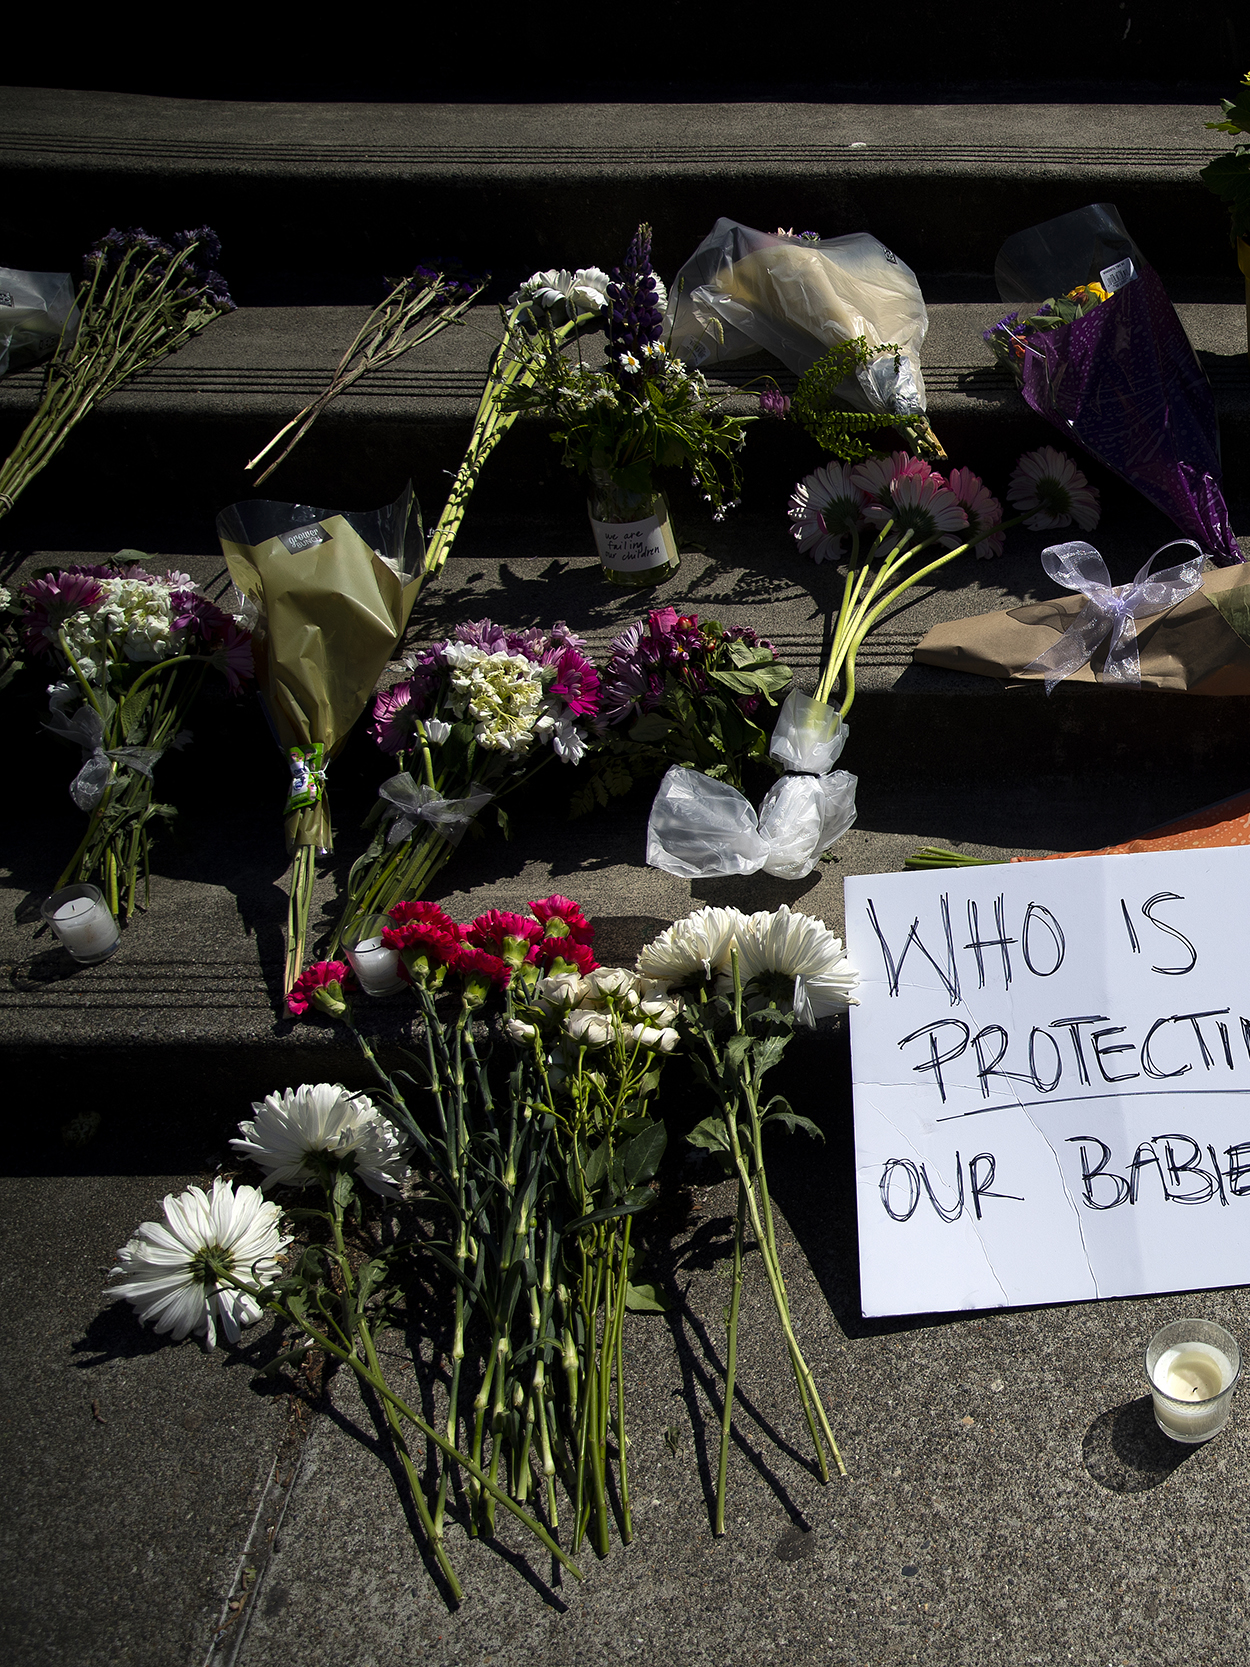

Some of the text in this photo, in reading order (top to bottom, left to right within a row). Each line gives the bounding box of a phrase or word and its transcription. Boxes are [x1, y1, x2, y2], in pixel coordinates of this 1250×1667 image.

[288, 528, 319, 548] grower
[296, 535, 321, 549] BUNCH
[624, 531, 643, 539] are
[608, 540, 643, 553] failing
[622, 546, 660, 560] children
[866, 892, 1198, 1006] WHO IS
[879, 1151, 1025, 1223] OUR
